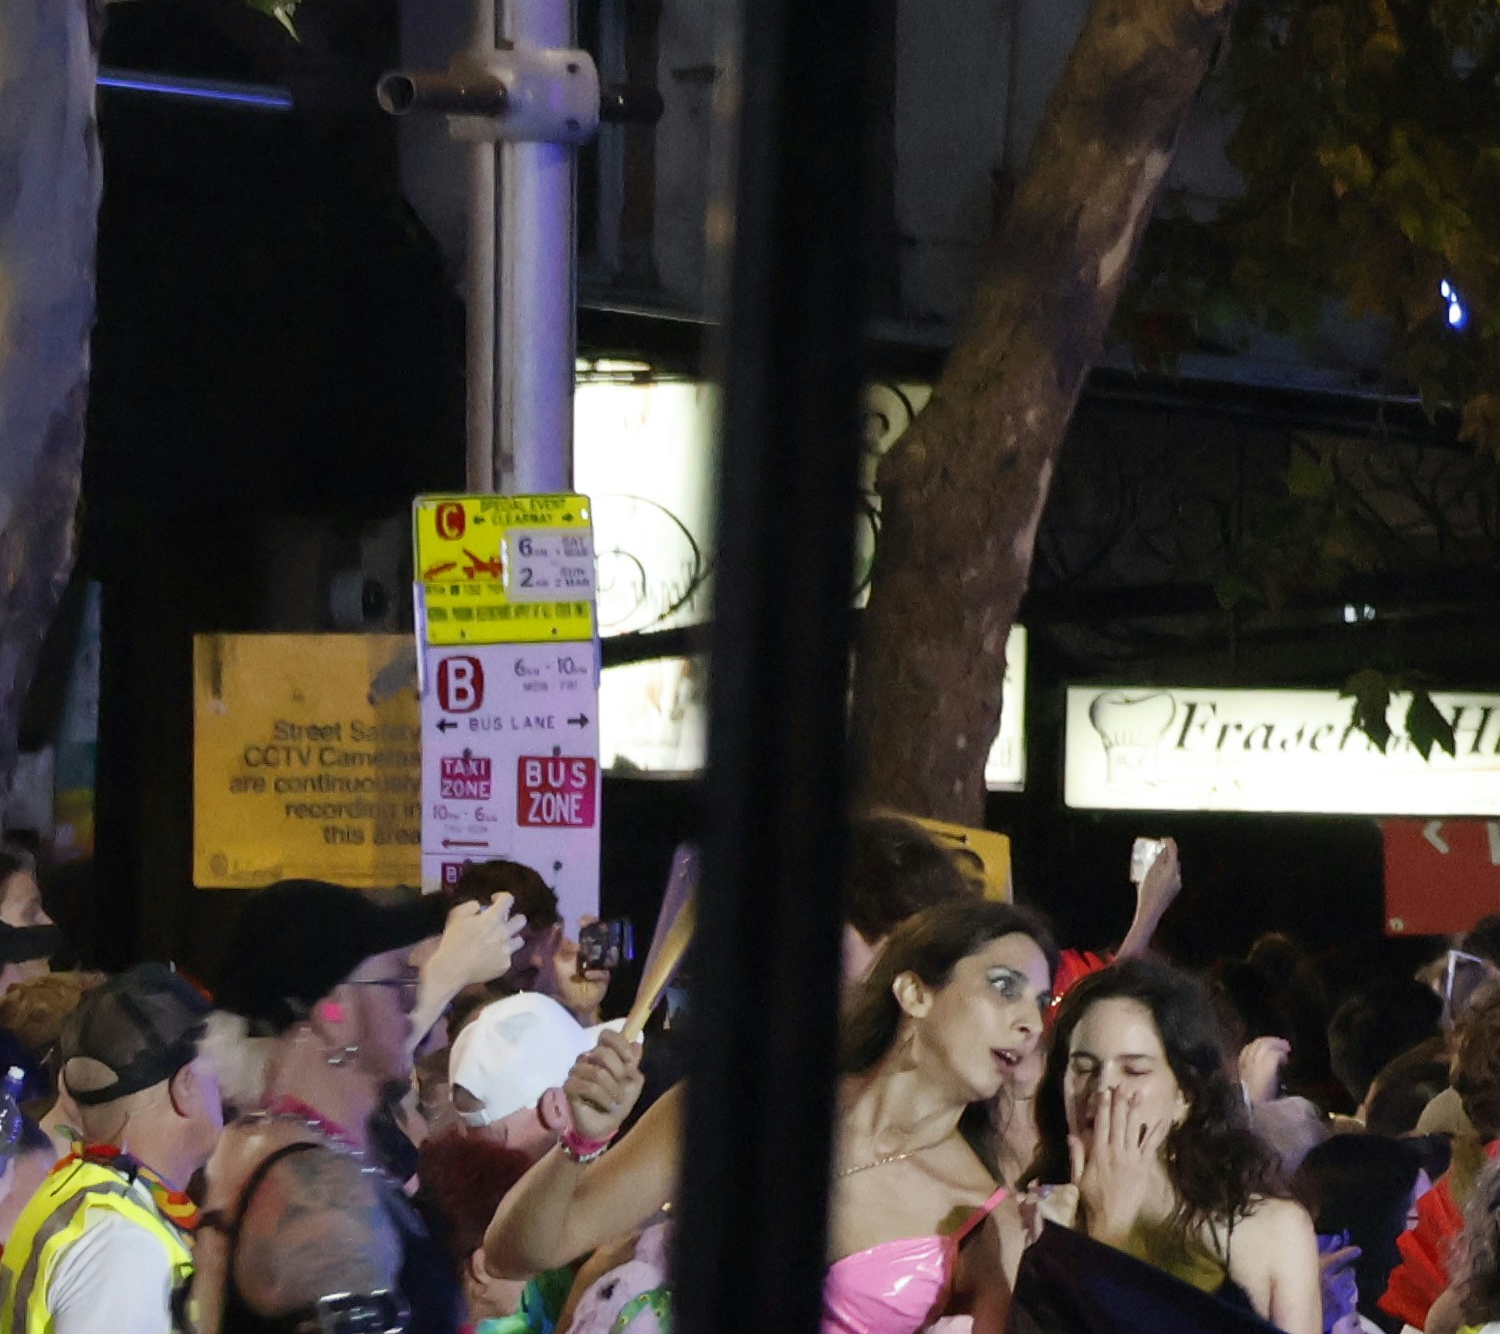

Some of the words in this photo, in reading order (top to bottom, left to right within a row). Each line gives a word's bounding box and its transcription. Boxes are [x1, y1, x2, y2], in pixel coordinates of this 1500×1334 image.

[441, 504, 461, 539] C
[446, 658, 475, 710] B
[273, 718, 342, 743] Street
[469, 717, 503, 733] BUS
[511, 715, 556, 731] LANE
[243, 745, 311, 768] CCTV
[443, 759, 487, 776] TAXI
[229, 774, 267, 794] are
[525, 759, 588, 789] BUS
[441, 780, 491, 799] ZONE
[528, 792, 584, 825] ZONE
[322, 824, 365, 845] this
